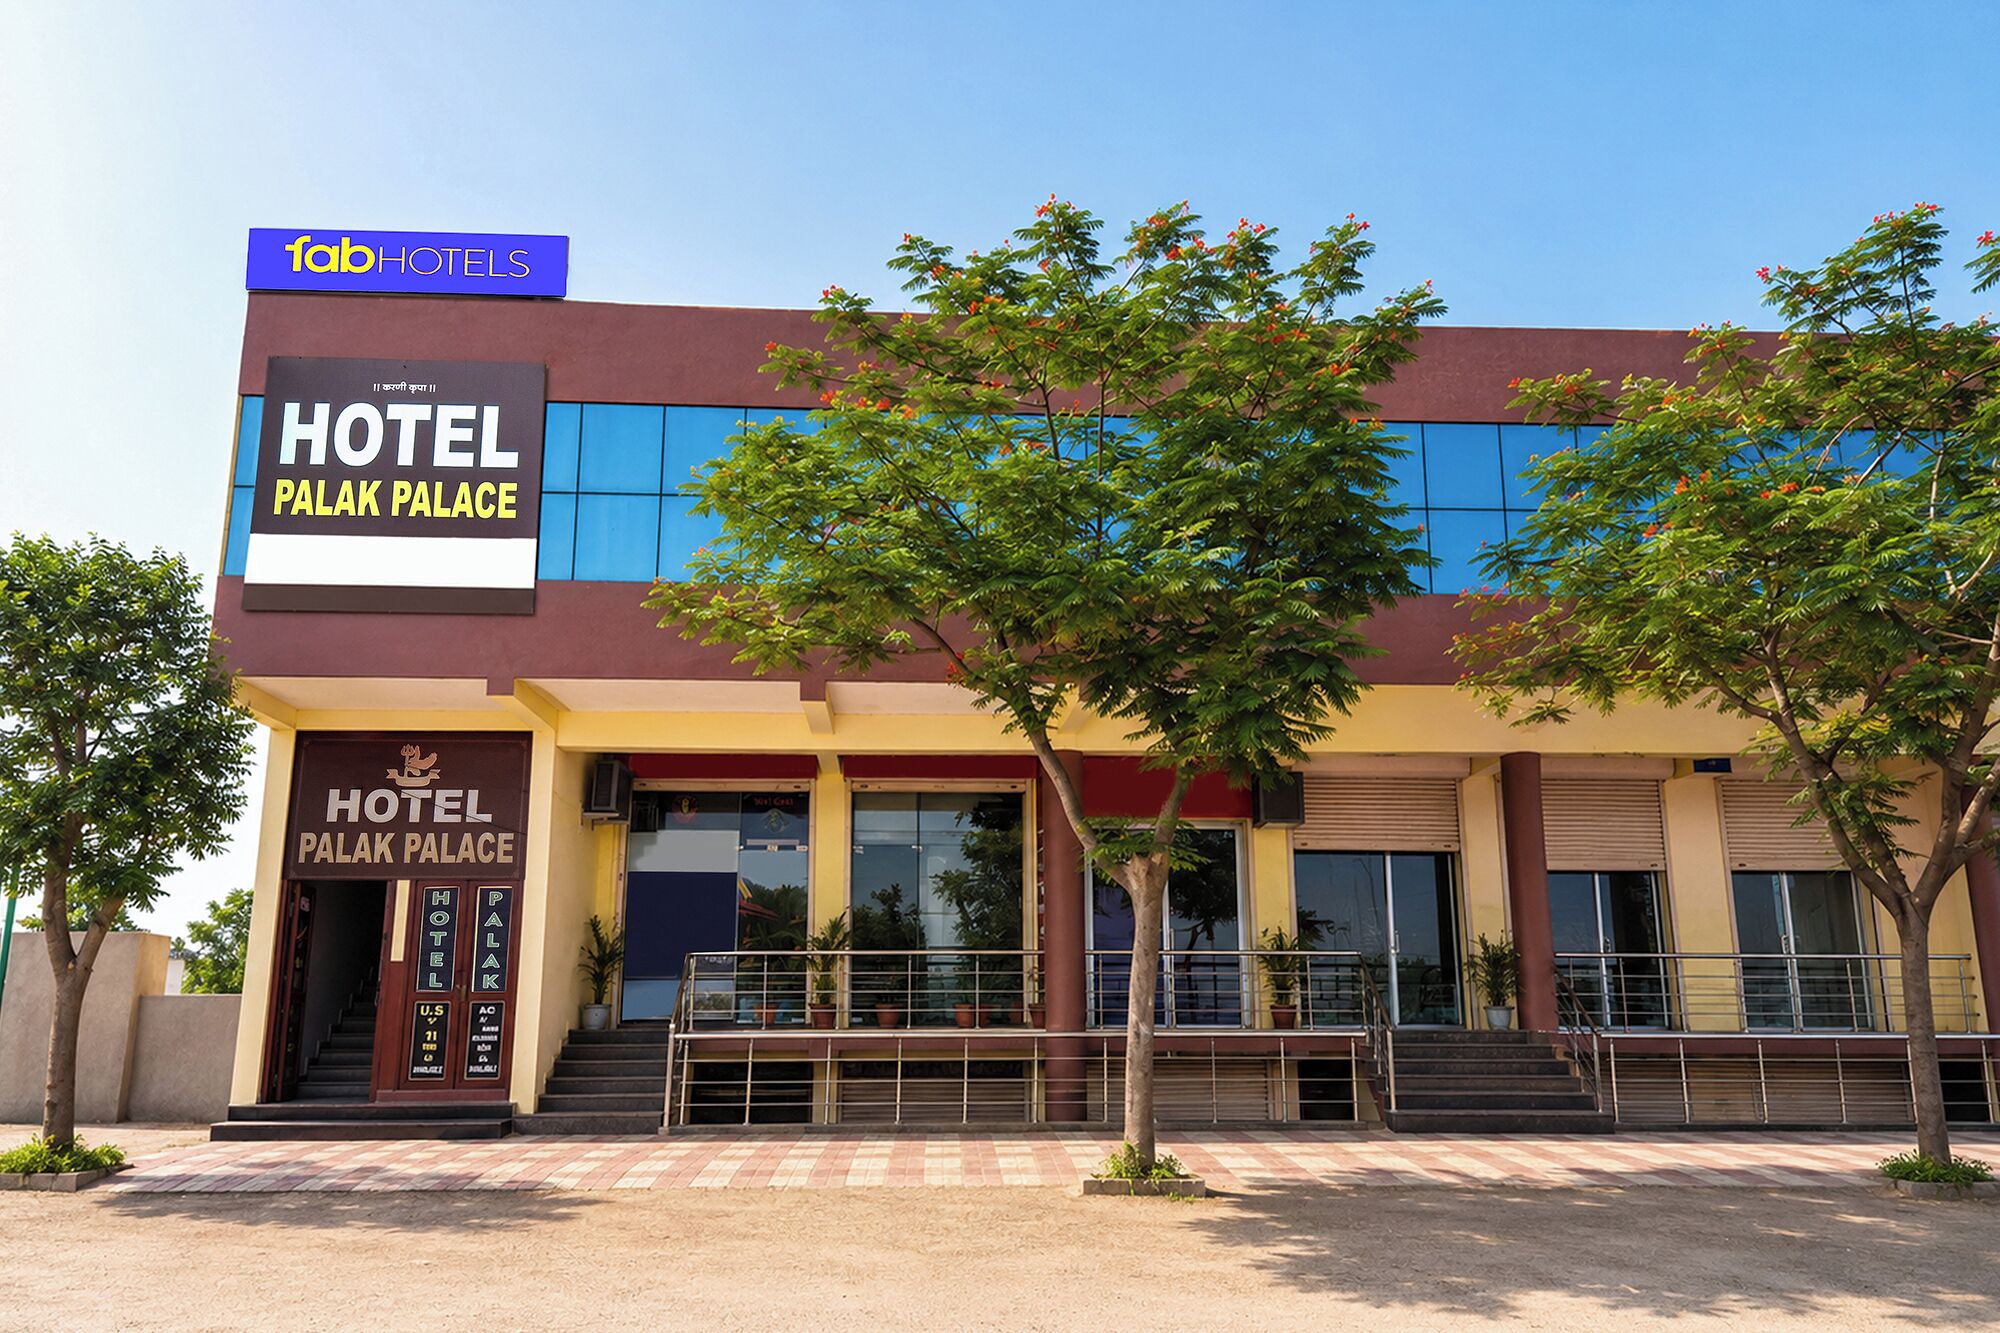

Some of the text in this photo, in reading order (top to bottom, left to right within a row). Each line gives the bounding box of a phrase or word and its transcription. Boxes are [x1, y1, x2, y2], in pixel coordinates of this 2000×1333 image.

[382, 381, 407, 392] करणी
[408, 383, 427, 395] कृपा
[279, 402, 519, 468] HOTEL
[273, 479, 518, 519] PALAK PALACE
[326, 788, 493, 823] HOTEL
[298, 832, 514, 864] PALAK PALACE
[429, 890, 450, 988] HOTEL
[481, 891, 504, 989] PALAK
